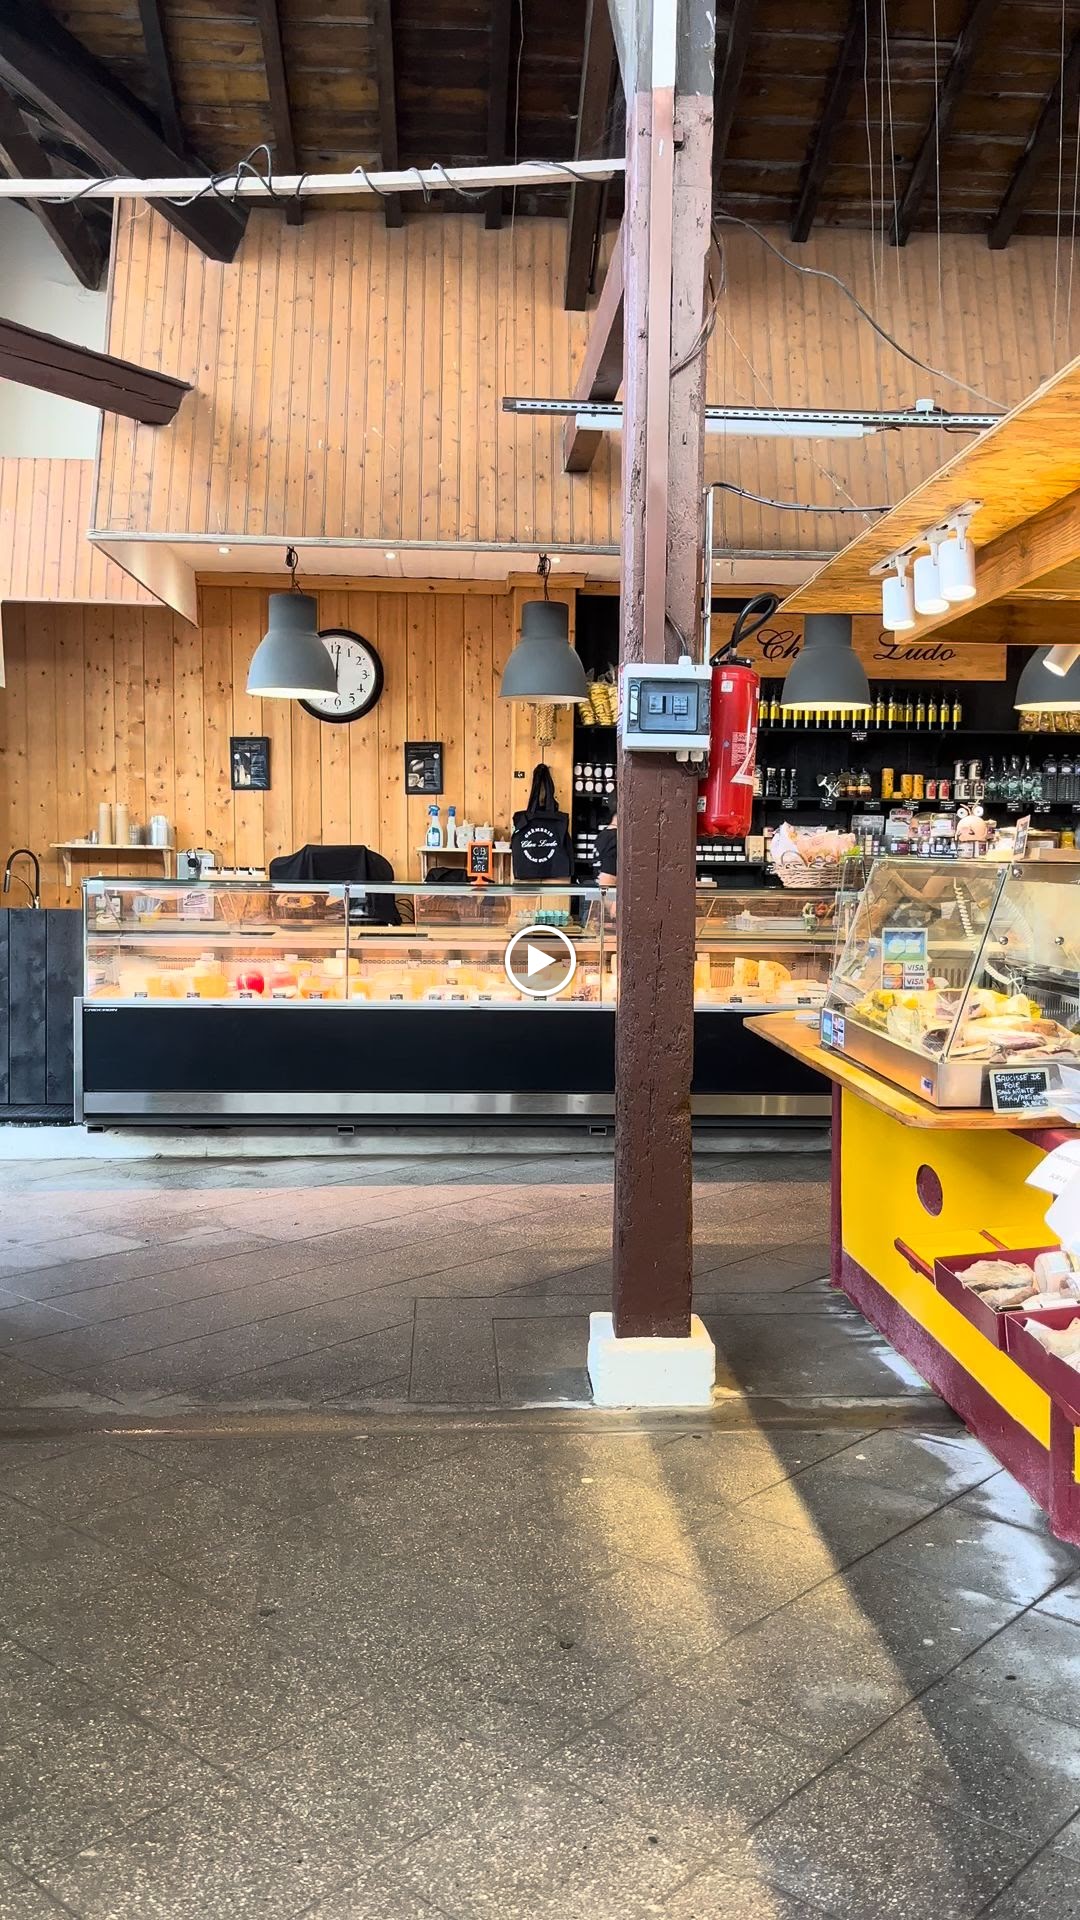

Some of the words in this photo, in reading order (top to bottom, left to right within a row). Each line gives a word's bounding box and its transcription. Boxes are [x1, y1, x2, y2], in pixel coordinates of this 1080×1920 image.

[331, 645, 341, 654] 12
[873, 630, 956, 661] Ludo
[356, 656, 362, 665] 2
[362, 670, 368, 679] 3
[357, 683, 364, 692] 4
[334, 697, 342, 707] 6
[349, 693, 355, 703] 5
